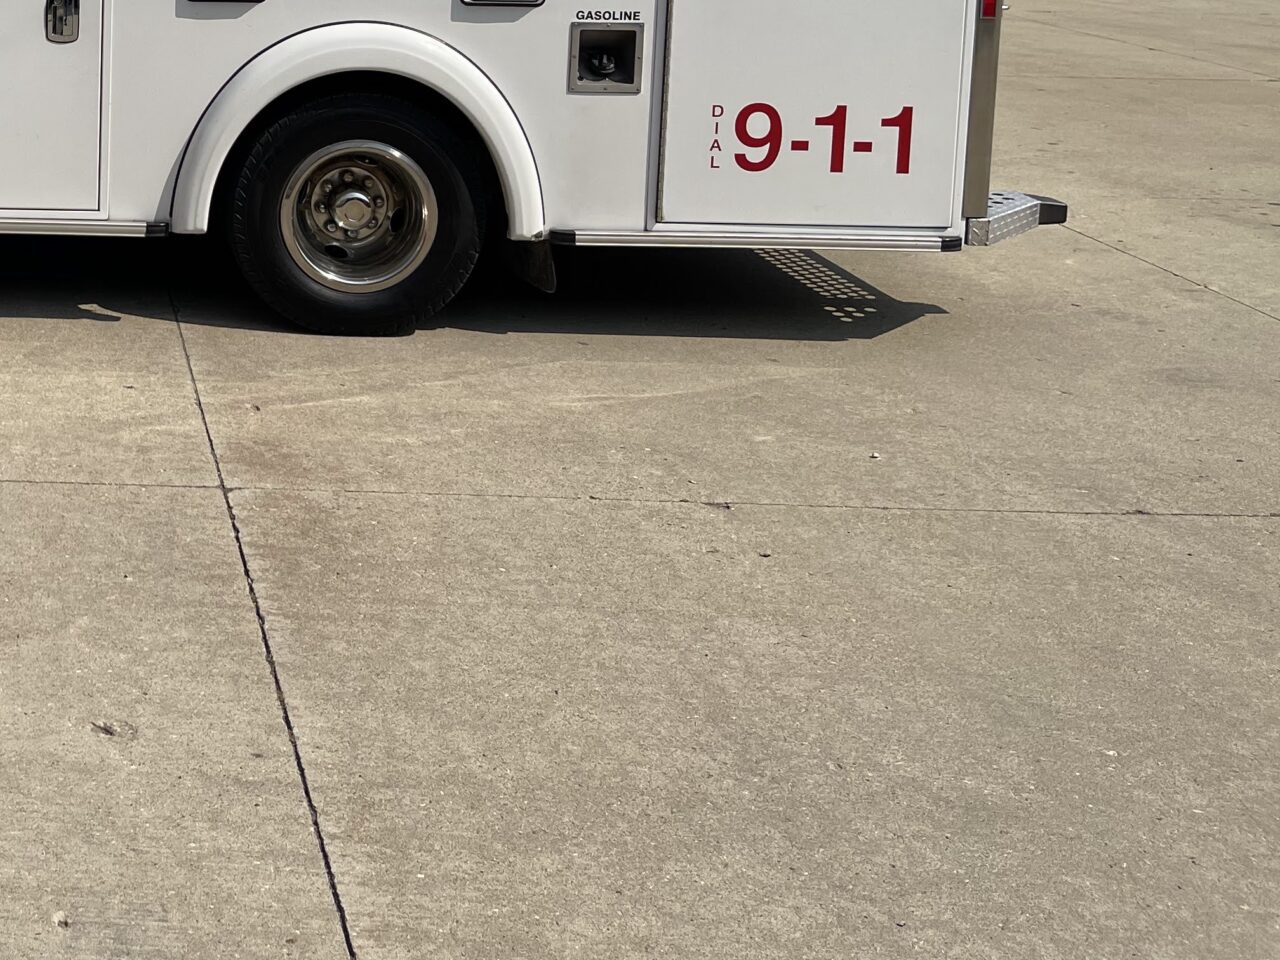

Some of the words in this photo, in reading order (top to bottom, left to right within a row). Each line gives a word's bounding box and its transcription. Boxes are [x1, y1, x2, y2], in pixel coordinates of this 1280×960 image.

[576, 10, 641, 21] GASOLINE
[709, 104, 724, 169] DIAL
[734, 102, 914, 174] 9-1-1
